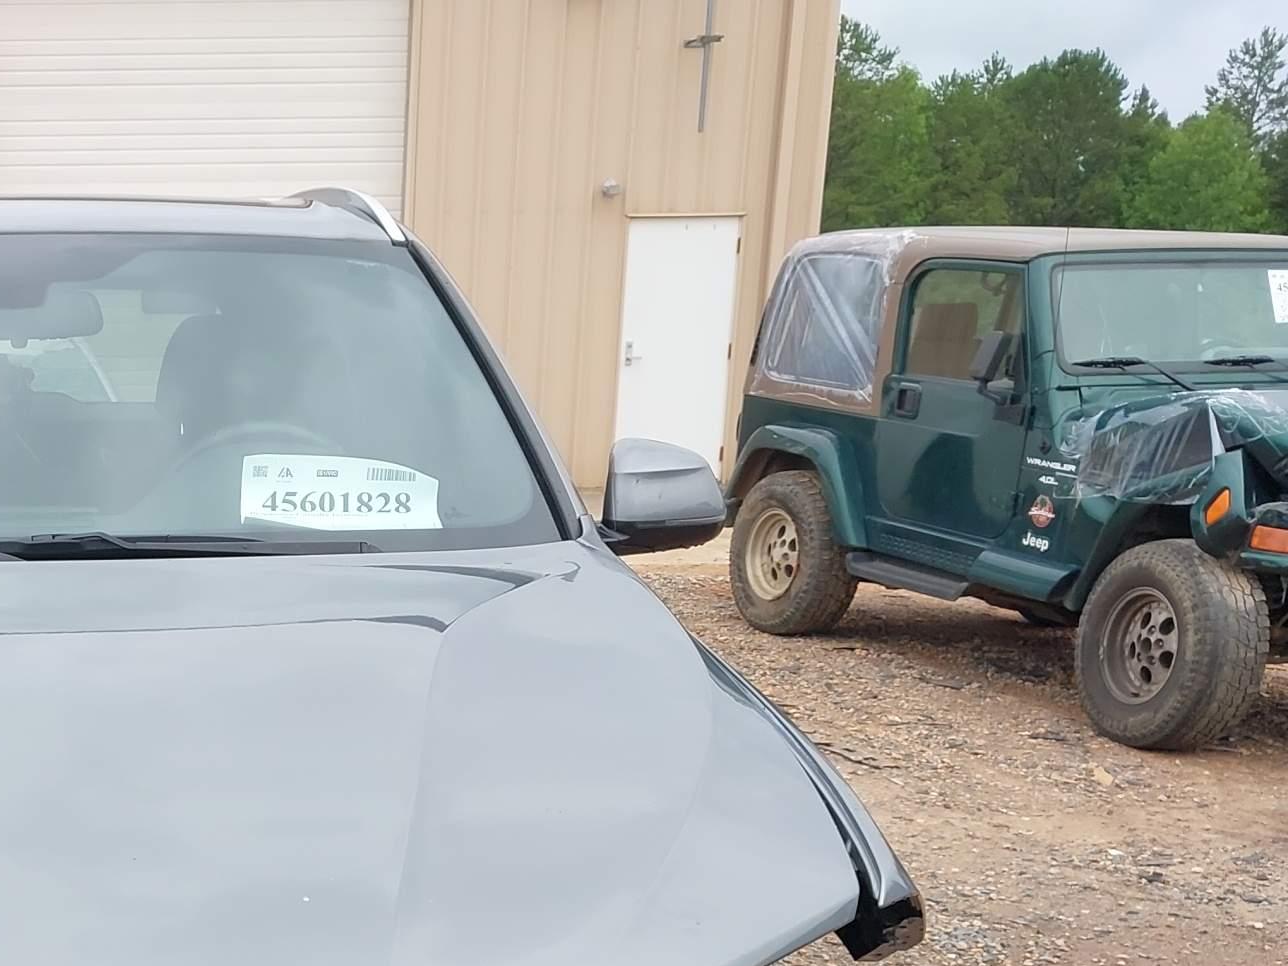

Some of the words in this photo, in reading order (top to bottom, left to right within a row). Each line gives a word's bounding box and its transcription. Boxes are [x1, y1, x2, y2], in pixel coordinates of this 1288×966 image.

[1026, 456, 1076, 472] WRANGLER
[262, 490, 412, 514] 45601828
[1022, 532, 1049, 552] Jeep
